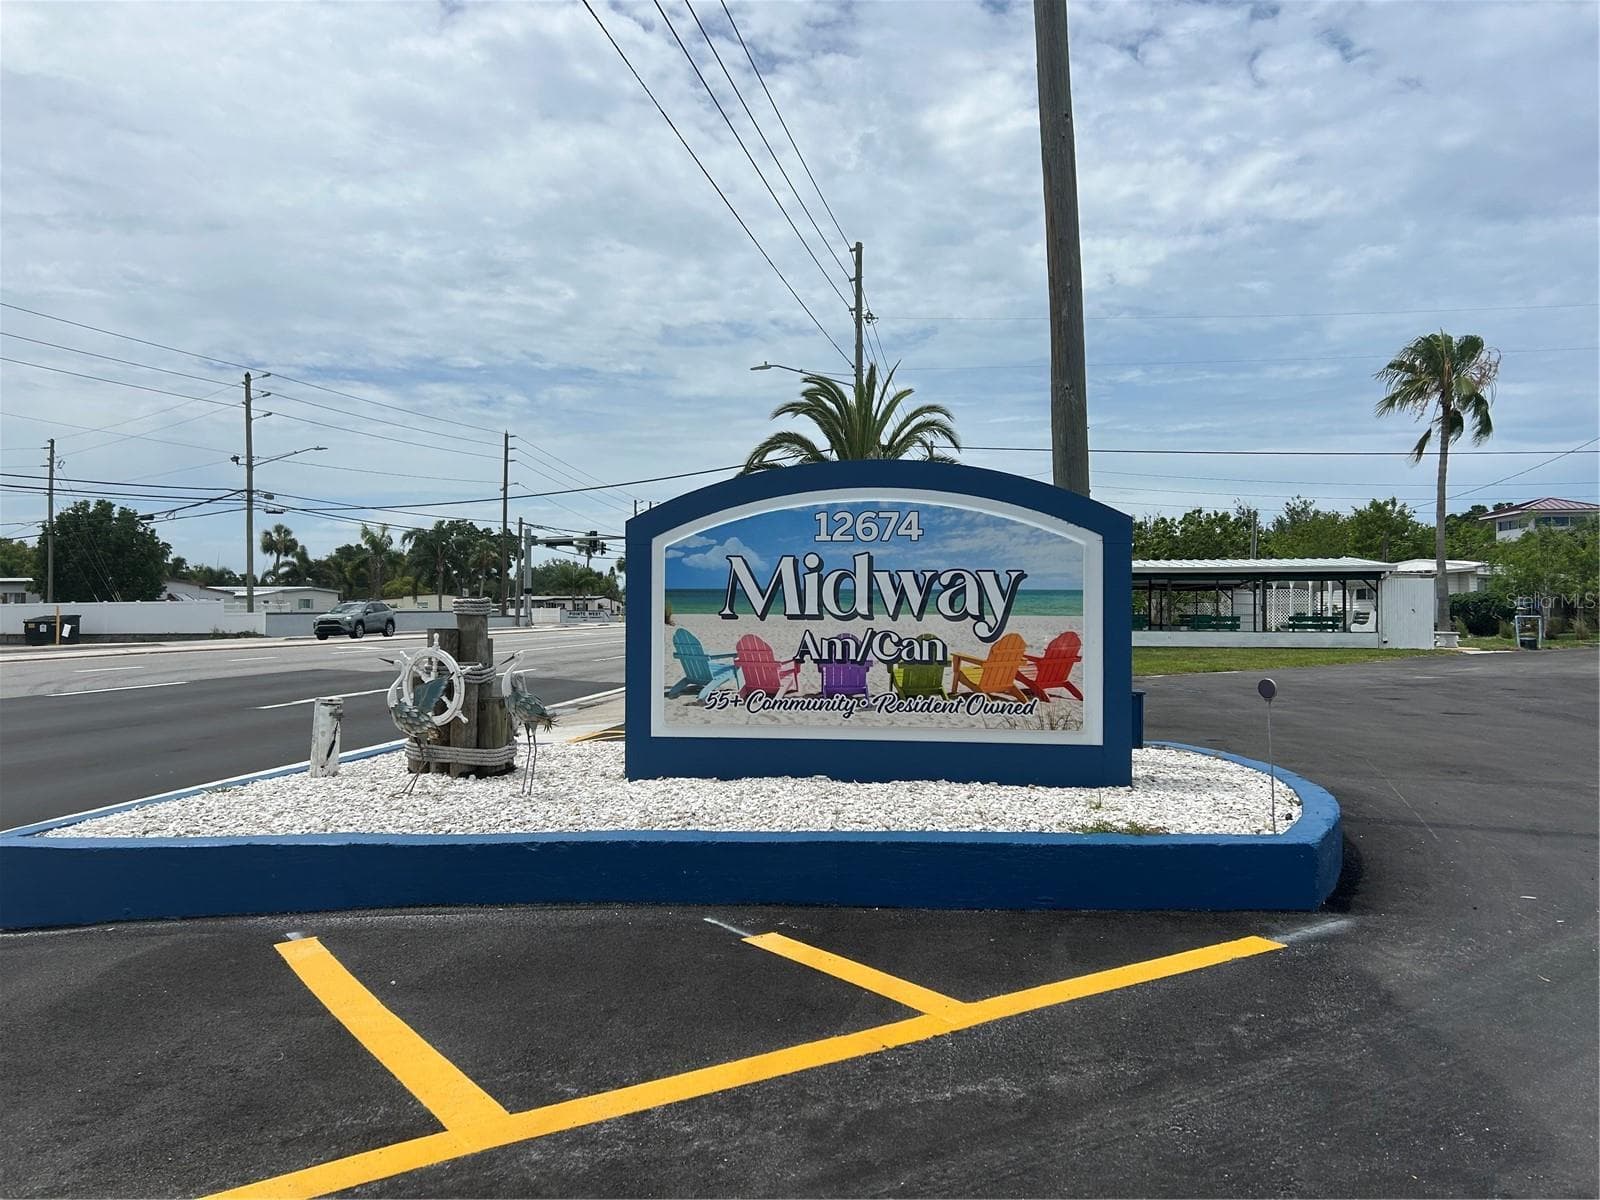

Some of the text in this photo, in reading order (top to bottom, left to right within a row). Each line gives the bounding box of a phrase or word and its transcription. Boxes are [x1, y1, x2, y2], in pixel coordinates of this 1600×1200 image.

[814, 511, 924, 542] 12674
[718, 552, 1028, 643] Midway
[794, 628, 948, 665] Am/Can
[704, 689, 1037, 719] 55+ Community Resident Owned
